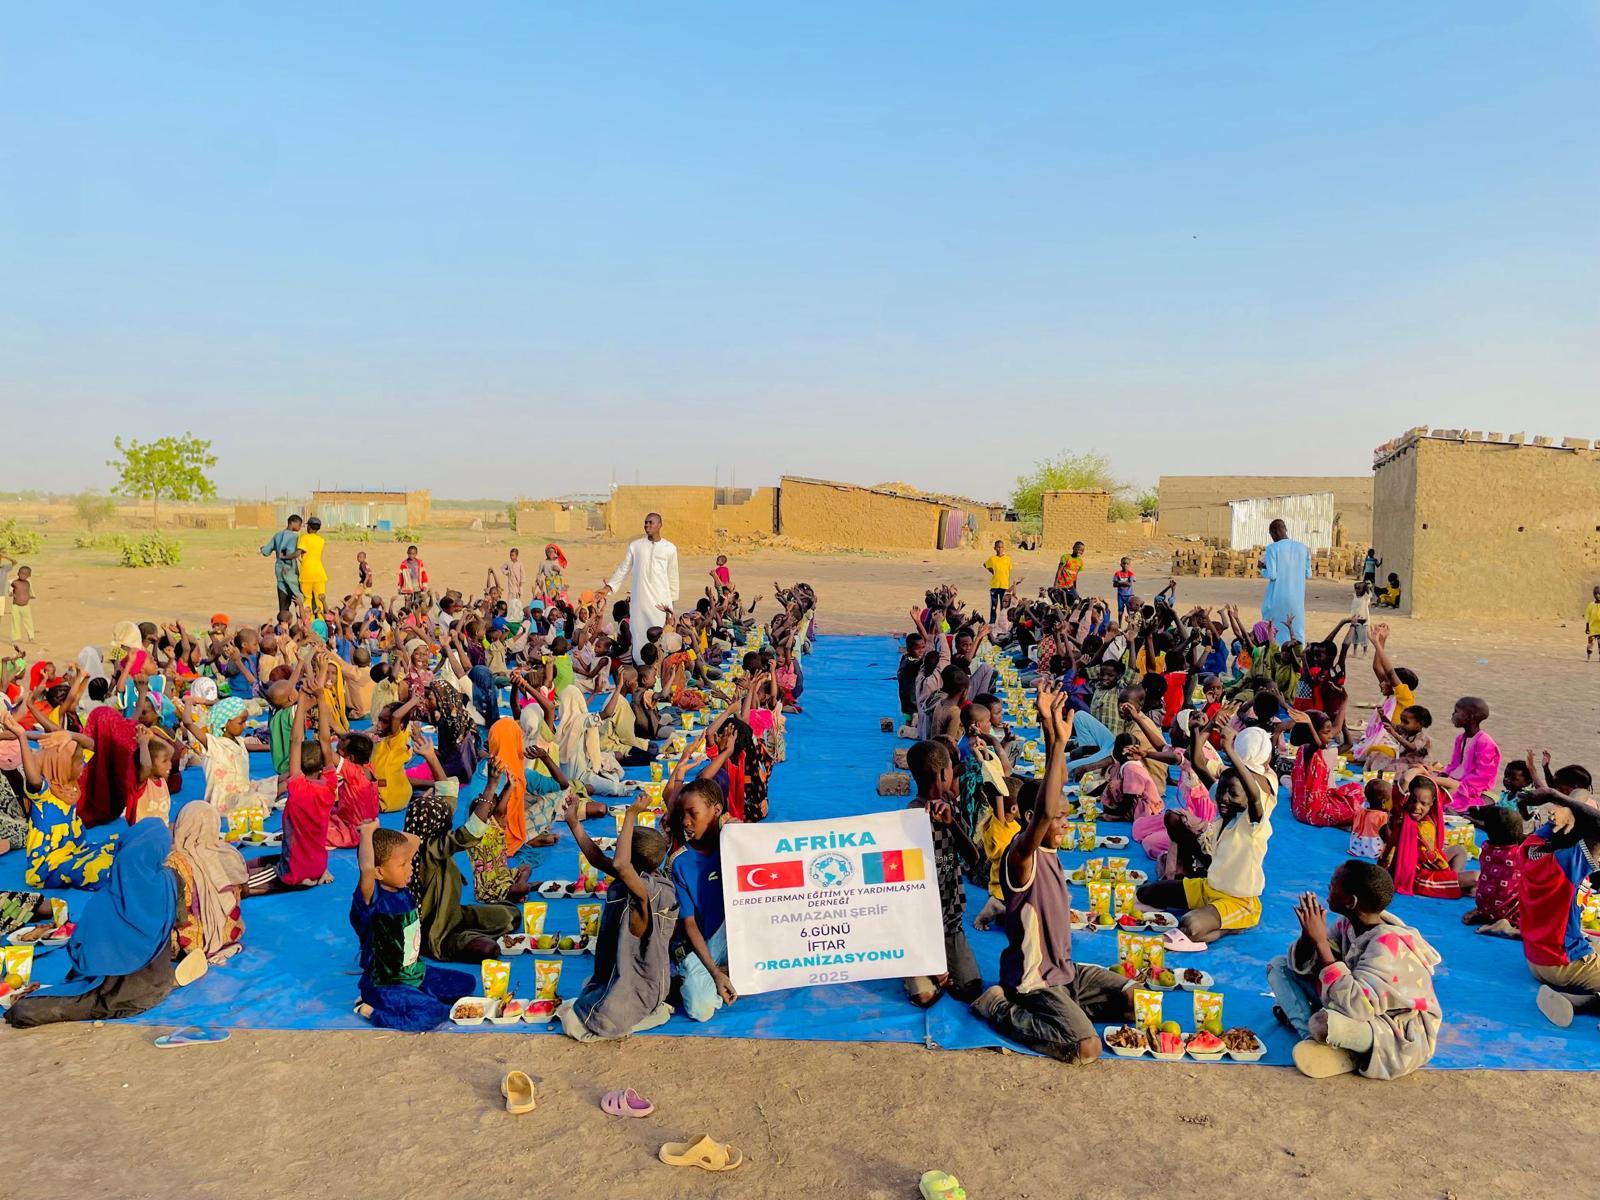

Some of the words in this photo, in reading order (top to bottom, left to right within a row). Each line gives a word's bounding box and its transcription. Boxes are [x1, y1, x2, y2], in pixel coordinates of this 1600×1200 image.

[775, 831, 877, 853] AFRİKA
[732, 896, 763, 906] DERDE
[764, 893, 805, 904] DERMAN
[807, 889, 841, 900] EĞİTİM
[857, 883, 926, 896] YARDIMLAŞMA
[807, 897, 850, 908] DERNEĞİ
[770, 910, 847, 925] RAMAZANI
[850, 905, 889, 919] ŞERİF
[800, 923, 851, 938] 6.GÜNÜ
[807, 939, 846, 952] İFTAR
[754, 949, 905, 971] ORGANİZASYONU
[809, 971, 850, 984] 2025
